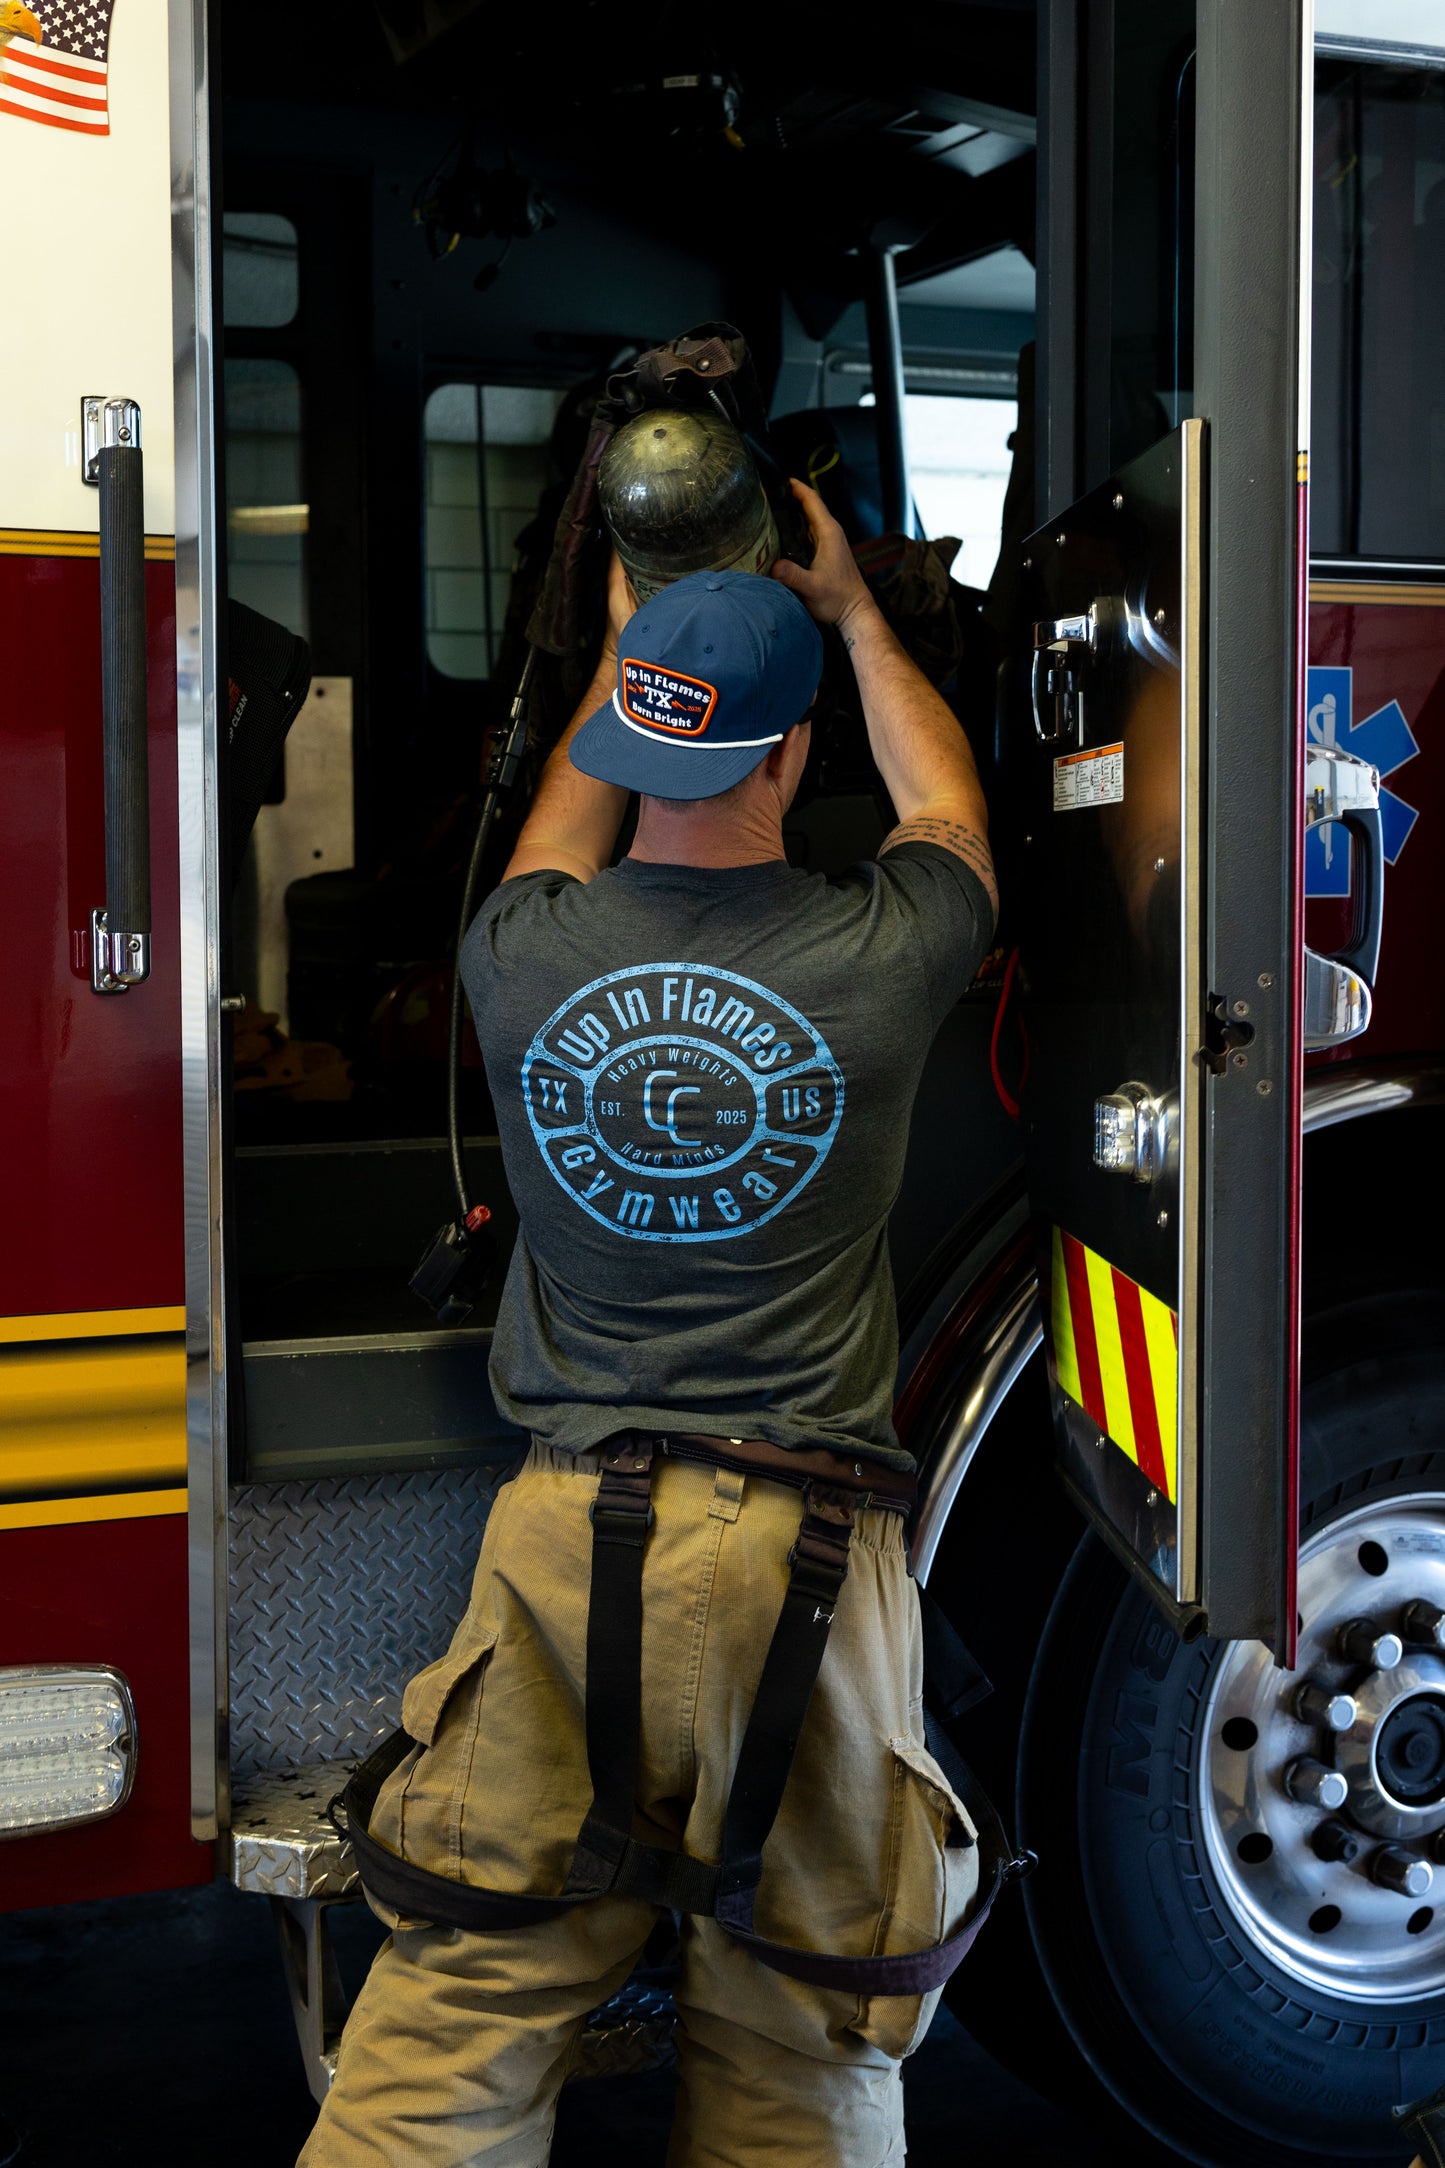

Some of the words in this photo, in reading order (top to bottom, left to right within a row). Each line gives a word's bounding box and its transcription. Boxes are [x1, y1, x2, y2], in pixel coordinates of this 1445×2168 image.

[626, 666, 637, 681] Up
[655, 676, 711, 704] Flames
[644, 686, 673, 710] TX
[232, 694, 248, 728] CLEAN
[632, 701, 652, 718] Burn
[654, 711, 692, 728] Bright
[557, 1011, 611, 1063] Up
[606, 987, 651, 1031] In
[662, 977, 793, 1068] Flames
[607, 1050, 657, 1084] Heavy
[668, 1048, 738, 1087] Weights
[538, 1078, 569, 1115] TX
[601, 1100, 626, 1117] EST.
[780, 1087, 822, 1123] US
[716, 1109, 748, 1125] 2025
[620, 1141, 662, 1166] Hard
[672, 1143, 727, 1167] Minds
[561, 1145, 798, 1229] Gymwear
